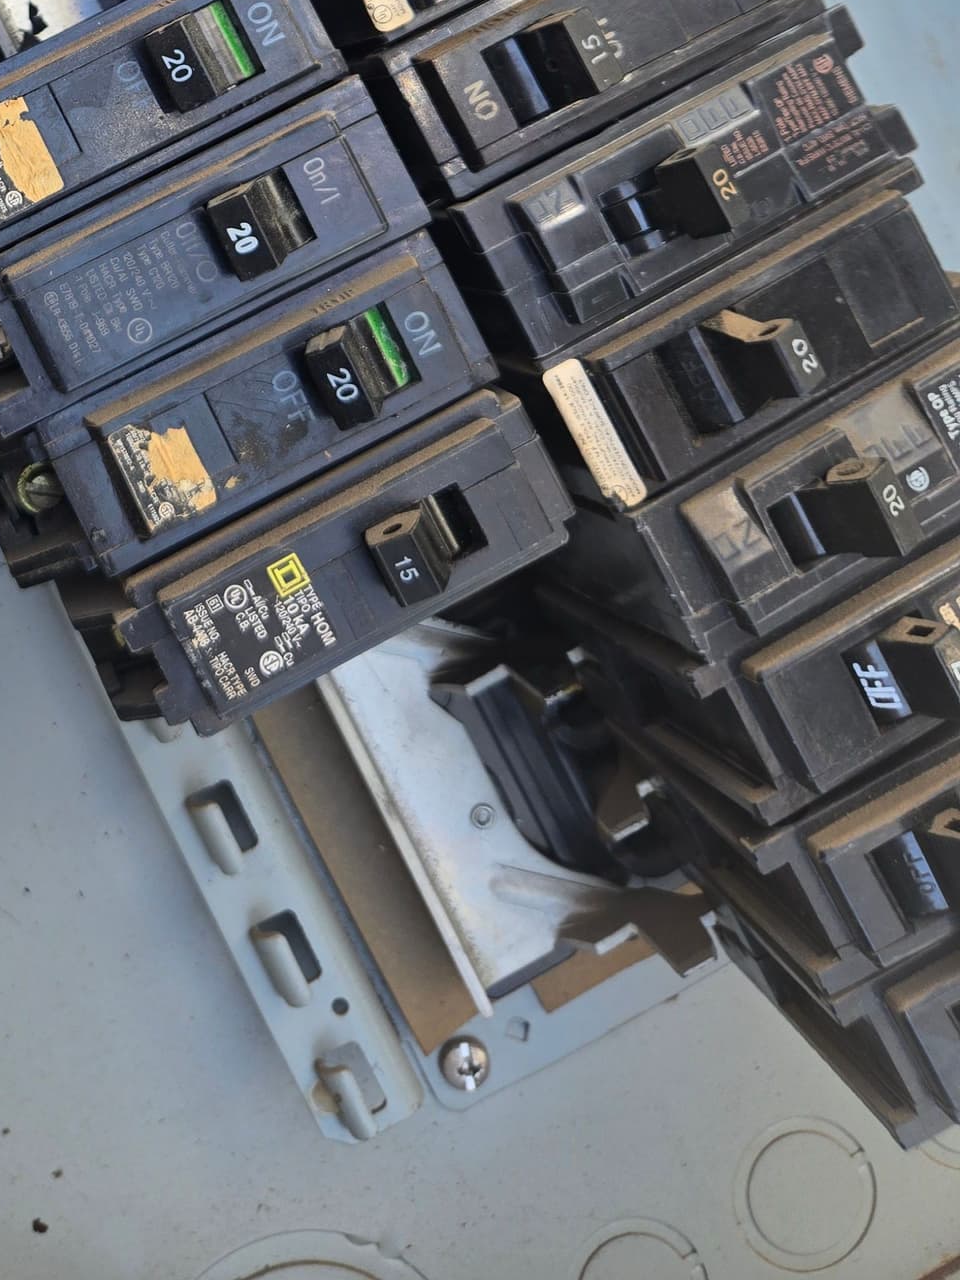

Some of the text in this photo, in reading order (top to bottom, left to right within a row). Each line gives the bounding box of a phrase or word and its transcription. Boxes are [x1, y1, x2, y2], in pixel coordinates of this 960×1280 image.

[247, 2, 286, 46] ON
[162, 49, 193, 83] 20
[582, 34, 608, 65] 15
[463, 80, 498, 121] ON
[712, 168, 738, 201] 20
[135, 243, 153, 266] Type
[147, 238, 164, 260] Type
[226, 222, 259, 254] 20
[404, 311, 443, 356] ON
[792, 337, 819, 375] 20
[272, 370, 316, 422] OFF
[327, 367, 359, 403] 20
[940, 409, 960, 440] Type
[882, 484, 906, 518] 20
[395, 556, 420, 583] 15
[273, 600, 297, 636] 120/240
[282, 595, 311, 635] 10 kA
[293, 590, 311, 613] TIPO
[302, 584, 336, 647] TYPE HOM
[193, 602, 213, 628] ISSUE
[205, 626, 220, 643] NO.
[244, 605, 267, 640] LISTED
[216, 650, 247, 698] HACR TYPE
[281, 650, 296, 667] Cu
[207, 656, 236, 700] TIPO CARR
[242, 666, 261, 688] SWD
[852, 662, 904, 709] OFF
